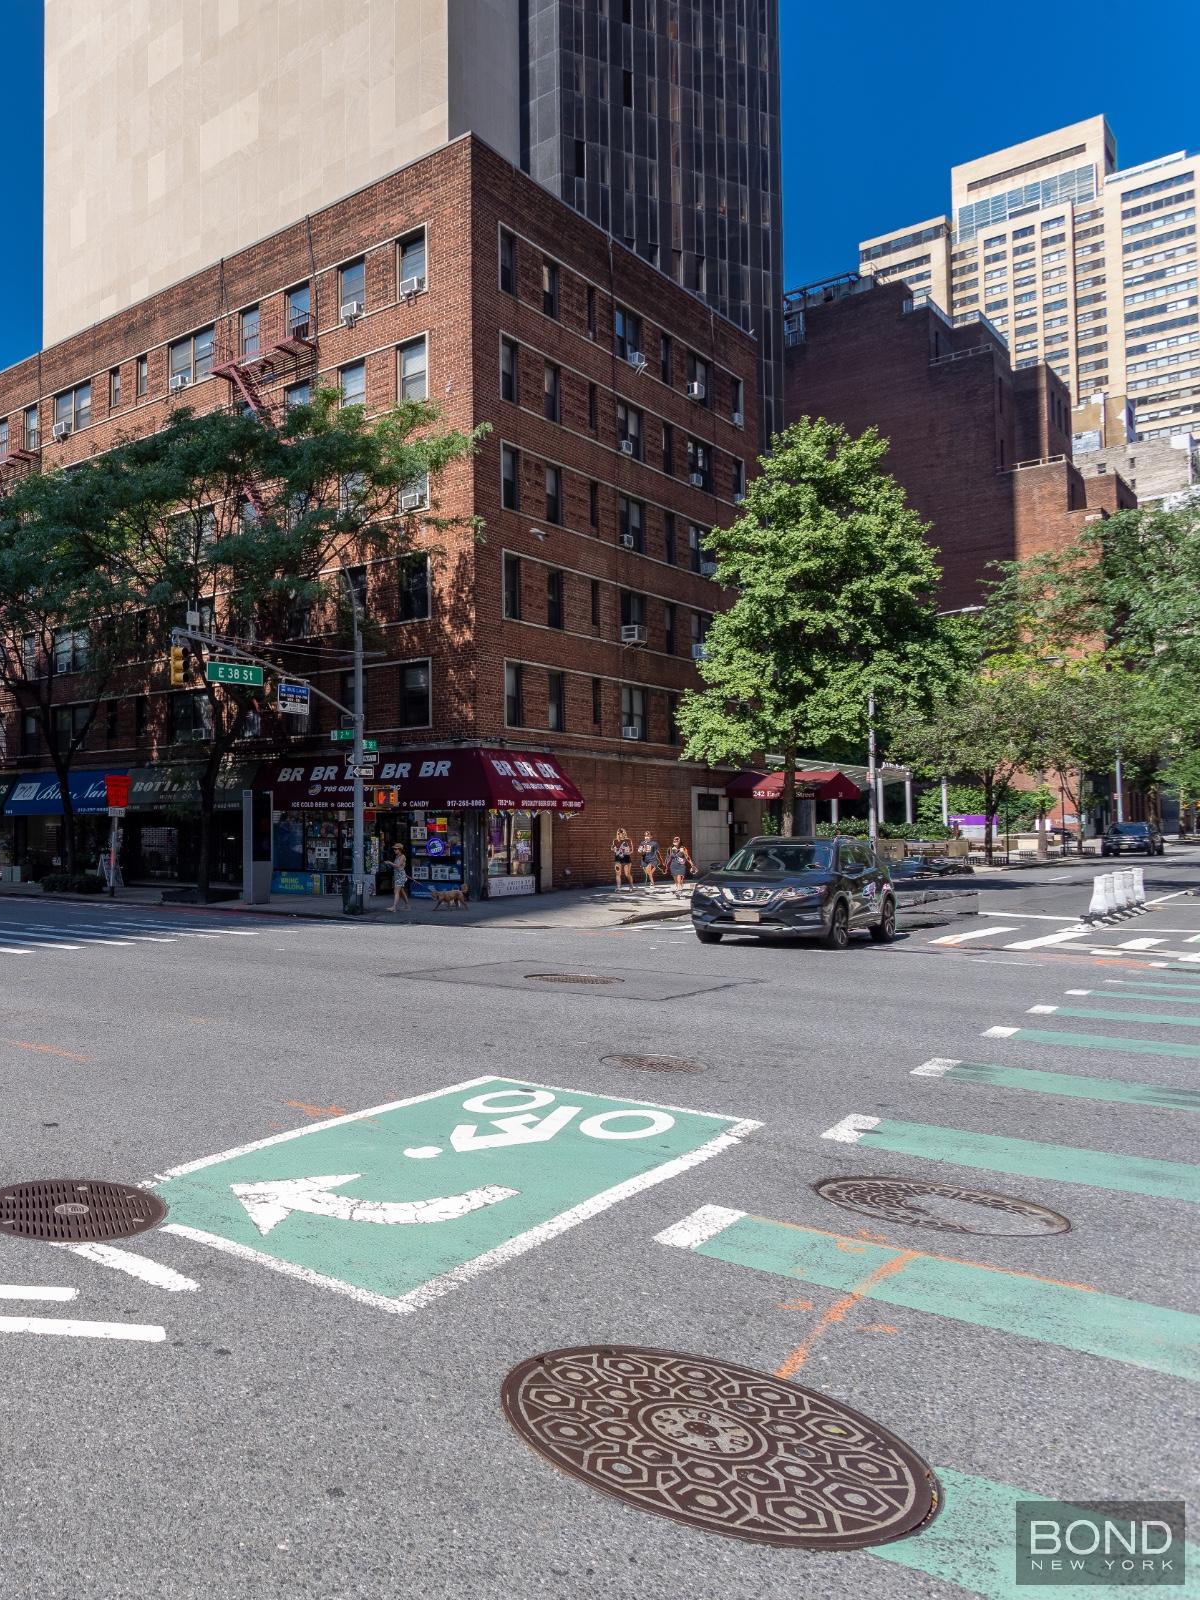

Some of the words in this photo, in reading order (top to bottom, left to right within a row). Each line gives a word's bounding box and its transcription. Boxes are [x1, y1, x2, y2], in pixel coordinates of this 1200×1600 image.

[217, 669, 225, 679] E
[228, 669, 240, 680] 38
[242, 670, 254, 682] St
[277, 767, 305, 782] BR
[310, 765, 339, 781] BR
[380, 762, 412, 779] BR
[418, 760, 452, 778] BR
[490, 759, 517, 777] BR
[513, 761, 539, 778] BR
[535, 762, 560, 779] BR
